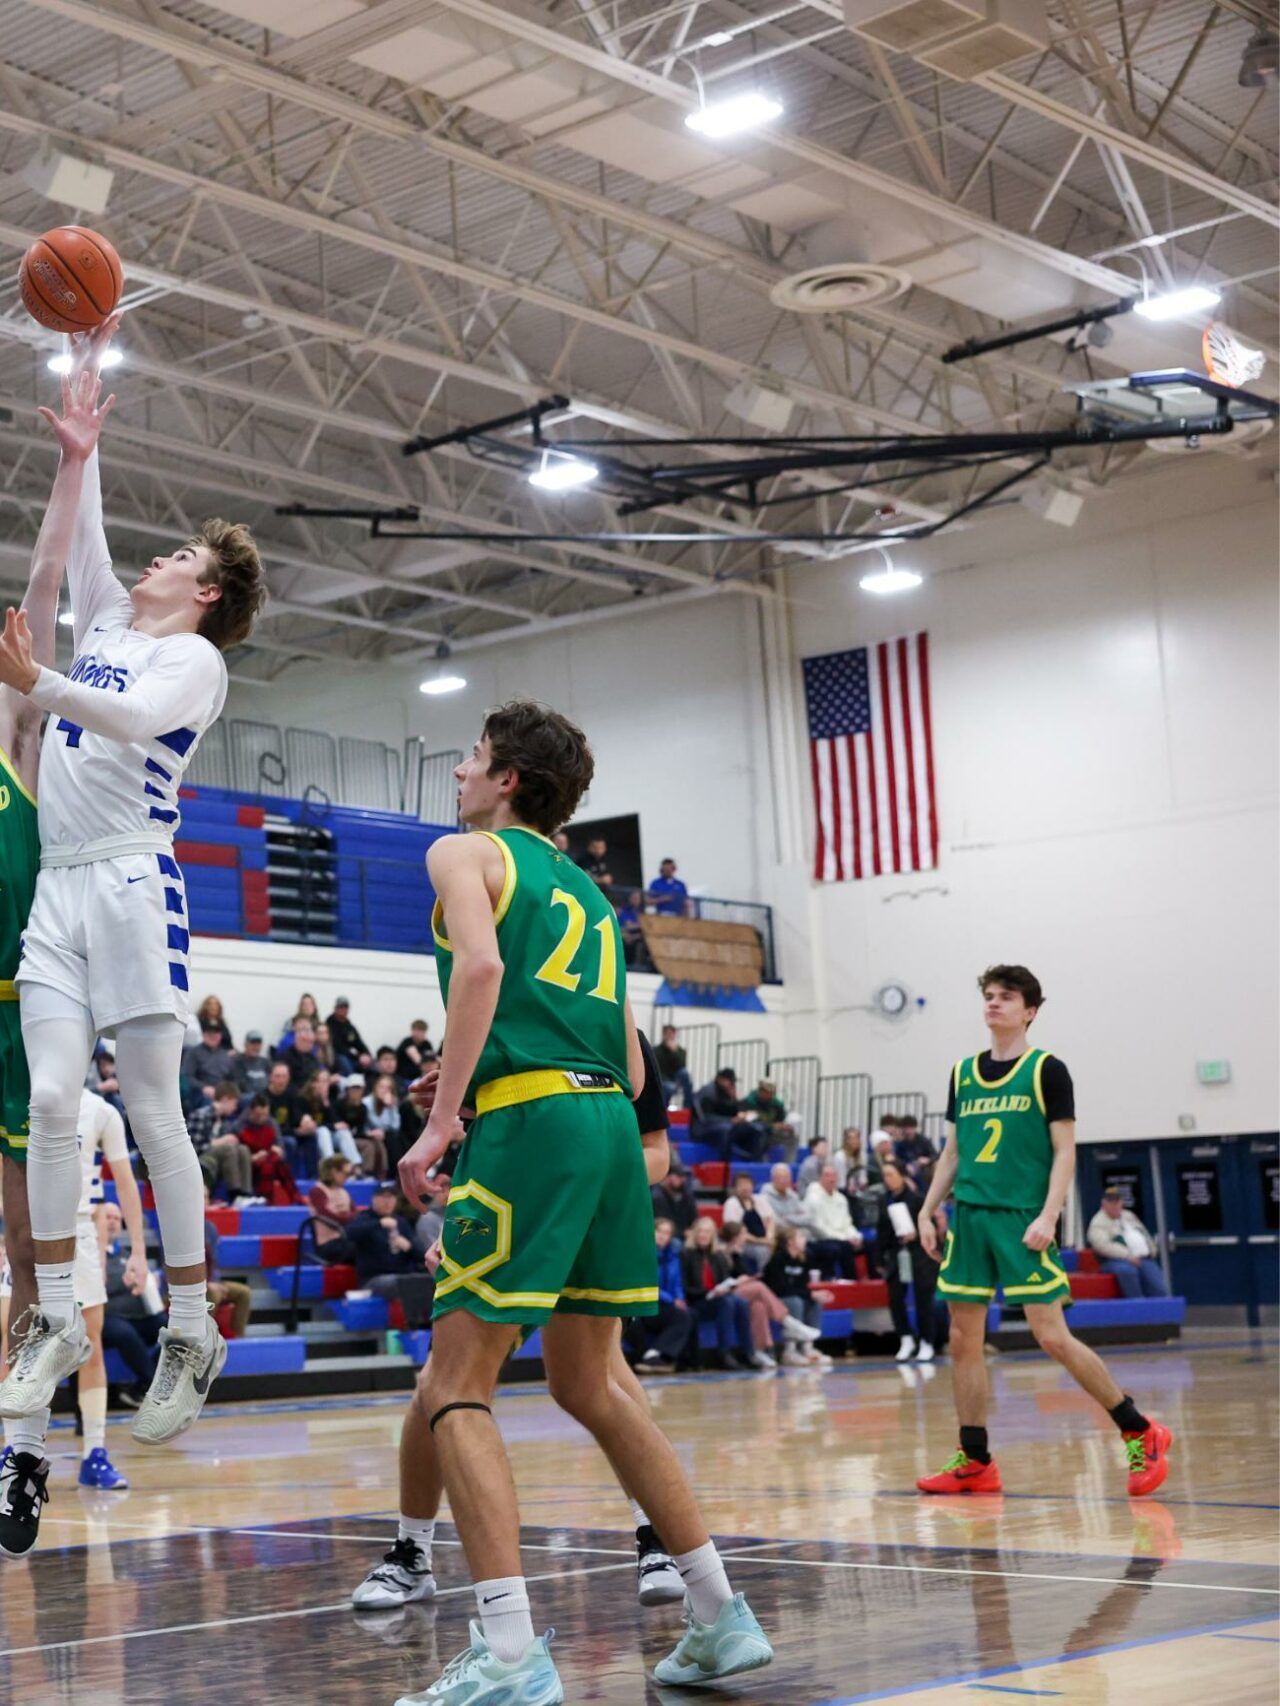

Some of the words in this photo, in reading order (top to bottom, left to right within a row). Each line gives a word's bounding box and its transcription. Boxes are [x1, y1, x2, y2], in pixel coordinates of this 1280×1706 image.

[534, 887, 619, 1005] 21
[959, 1095, 1032, 1117] LAKELAND
[974, 1118, 1003, 1163] 2
